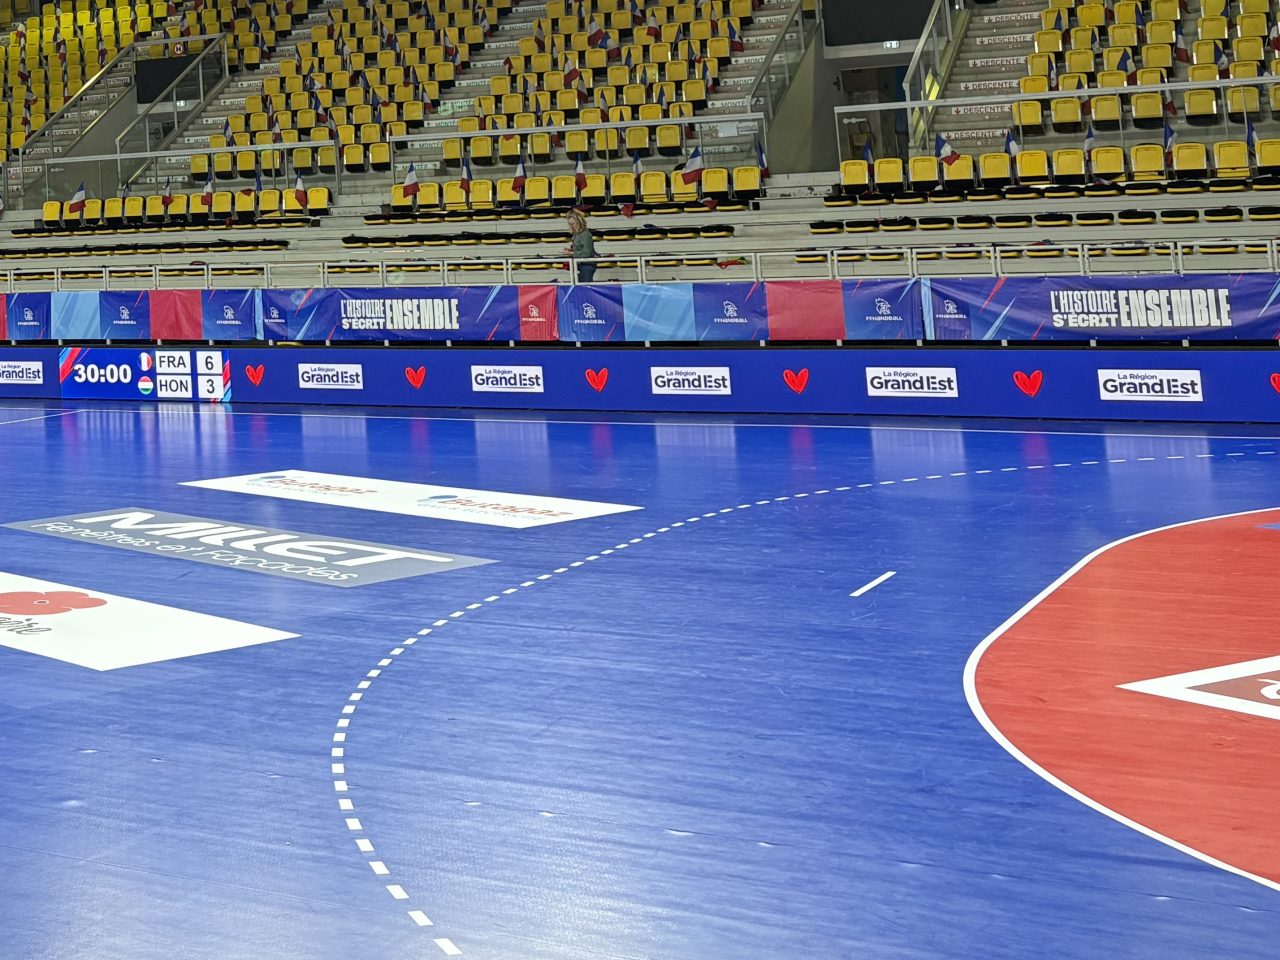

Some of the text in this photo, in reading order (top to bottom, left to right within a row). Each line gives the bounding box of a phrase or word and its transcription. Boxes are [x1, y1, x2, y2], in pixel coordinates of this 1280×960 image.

[972, 80, 1014, 90] DESCENTE
[963, 104, 1006, 114] DESCENTE
[954, 130, 997, 140] DESCENTE
[341, 299, 385, 318] L'HISTOIRE
[1050, 290, 1117, 313] L'HISTOIRE
[1118, 288, 1232, 327] ENSEMBLE
[385, 298, 460, 330] ENSEMBLE
[159, 355, 214, 371] FRA 6
[74, 363, 132, 384] 30:00
[159, 380, 215, 394] HON 3
[73, 511, 455, 568] MILLET
[31, 522, 359, 581] Fenêtres et Façades
